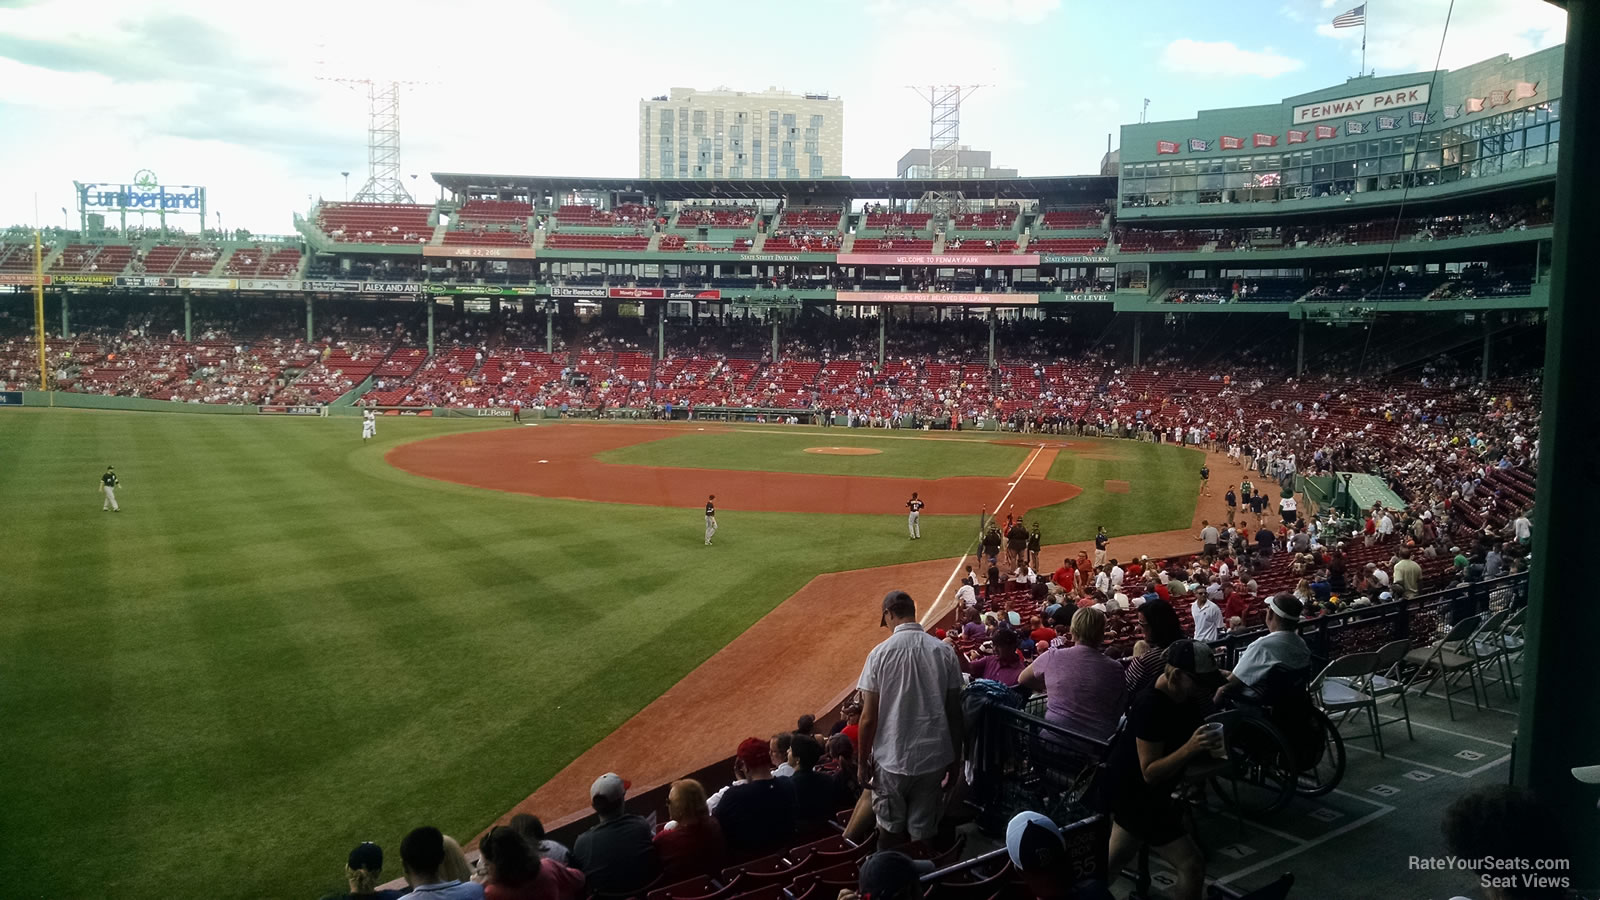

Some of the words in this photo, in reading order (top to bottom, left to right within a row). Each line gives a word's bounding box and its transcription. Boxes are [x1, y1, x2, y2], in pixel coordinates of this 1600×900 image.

[1300, 99, 1364, 120] FENWAY
[1373, 89, 1419, 107] PARK
[86, 185, 199, 209] Cumberland
[55, 275, 113, 283] 1-800-PAVEMENT
[365, 283, 385, 291] ALEX
[404, 284, 419, 292] ANI
[1072, 856, 1097, 879] 55
